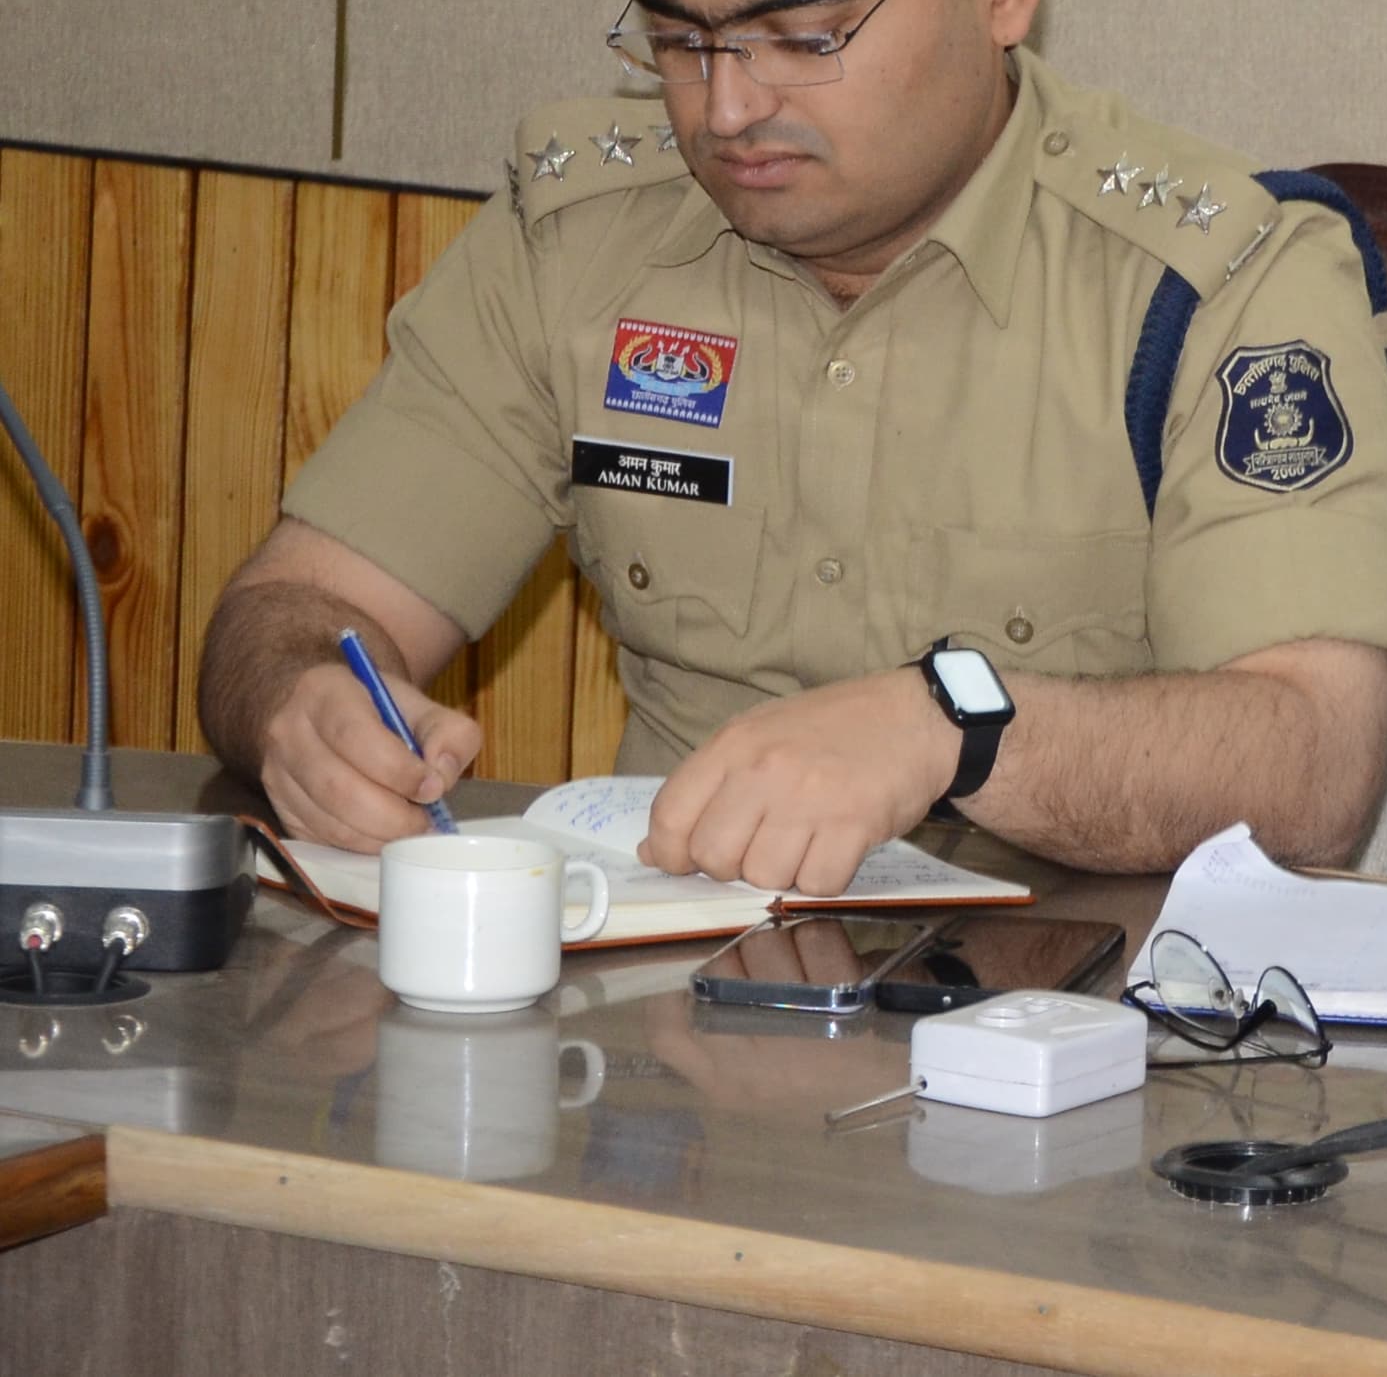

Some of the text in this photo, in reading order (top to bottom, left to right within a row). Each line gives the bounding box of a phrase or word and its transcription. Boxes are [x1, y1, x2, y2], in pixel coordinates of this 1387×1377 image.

[618, 454, 682, 477] अमन कुमार
[1271, 465, 1305, 481] 2000
[598, 470, 700, 497] AMAN KUMAR
